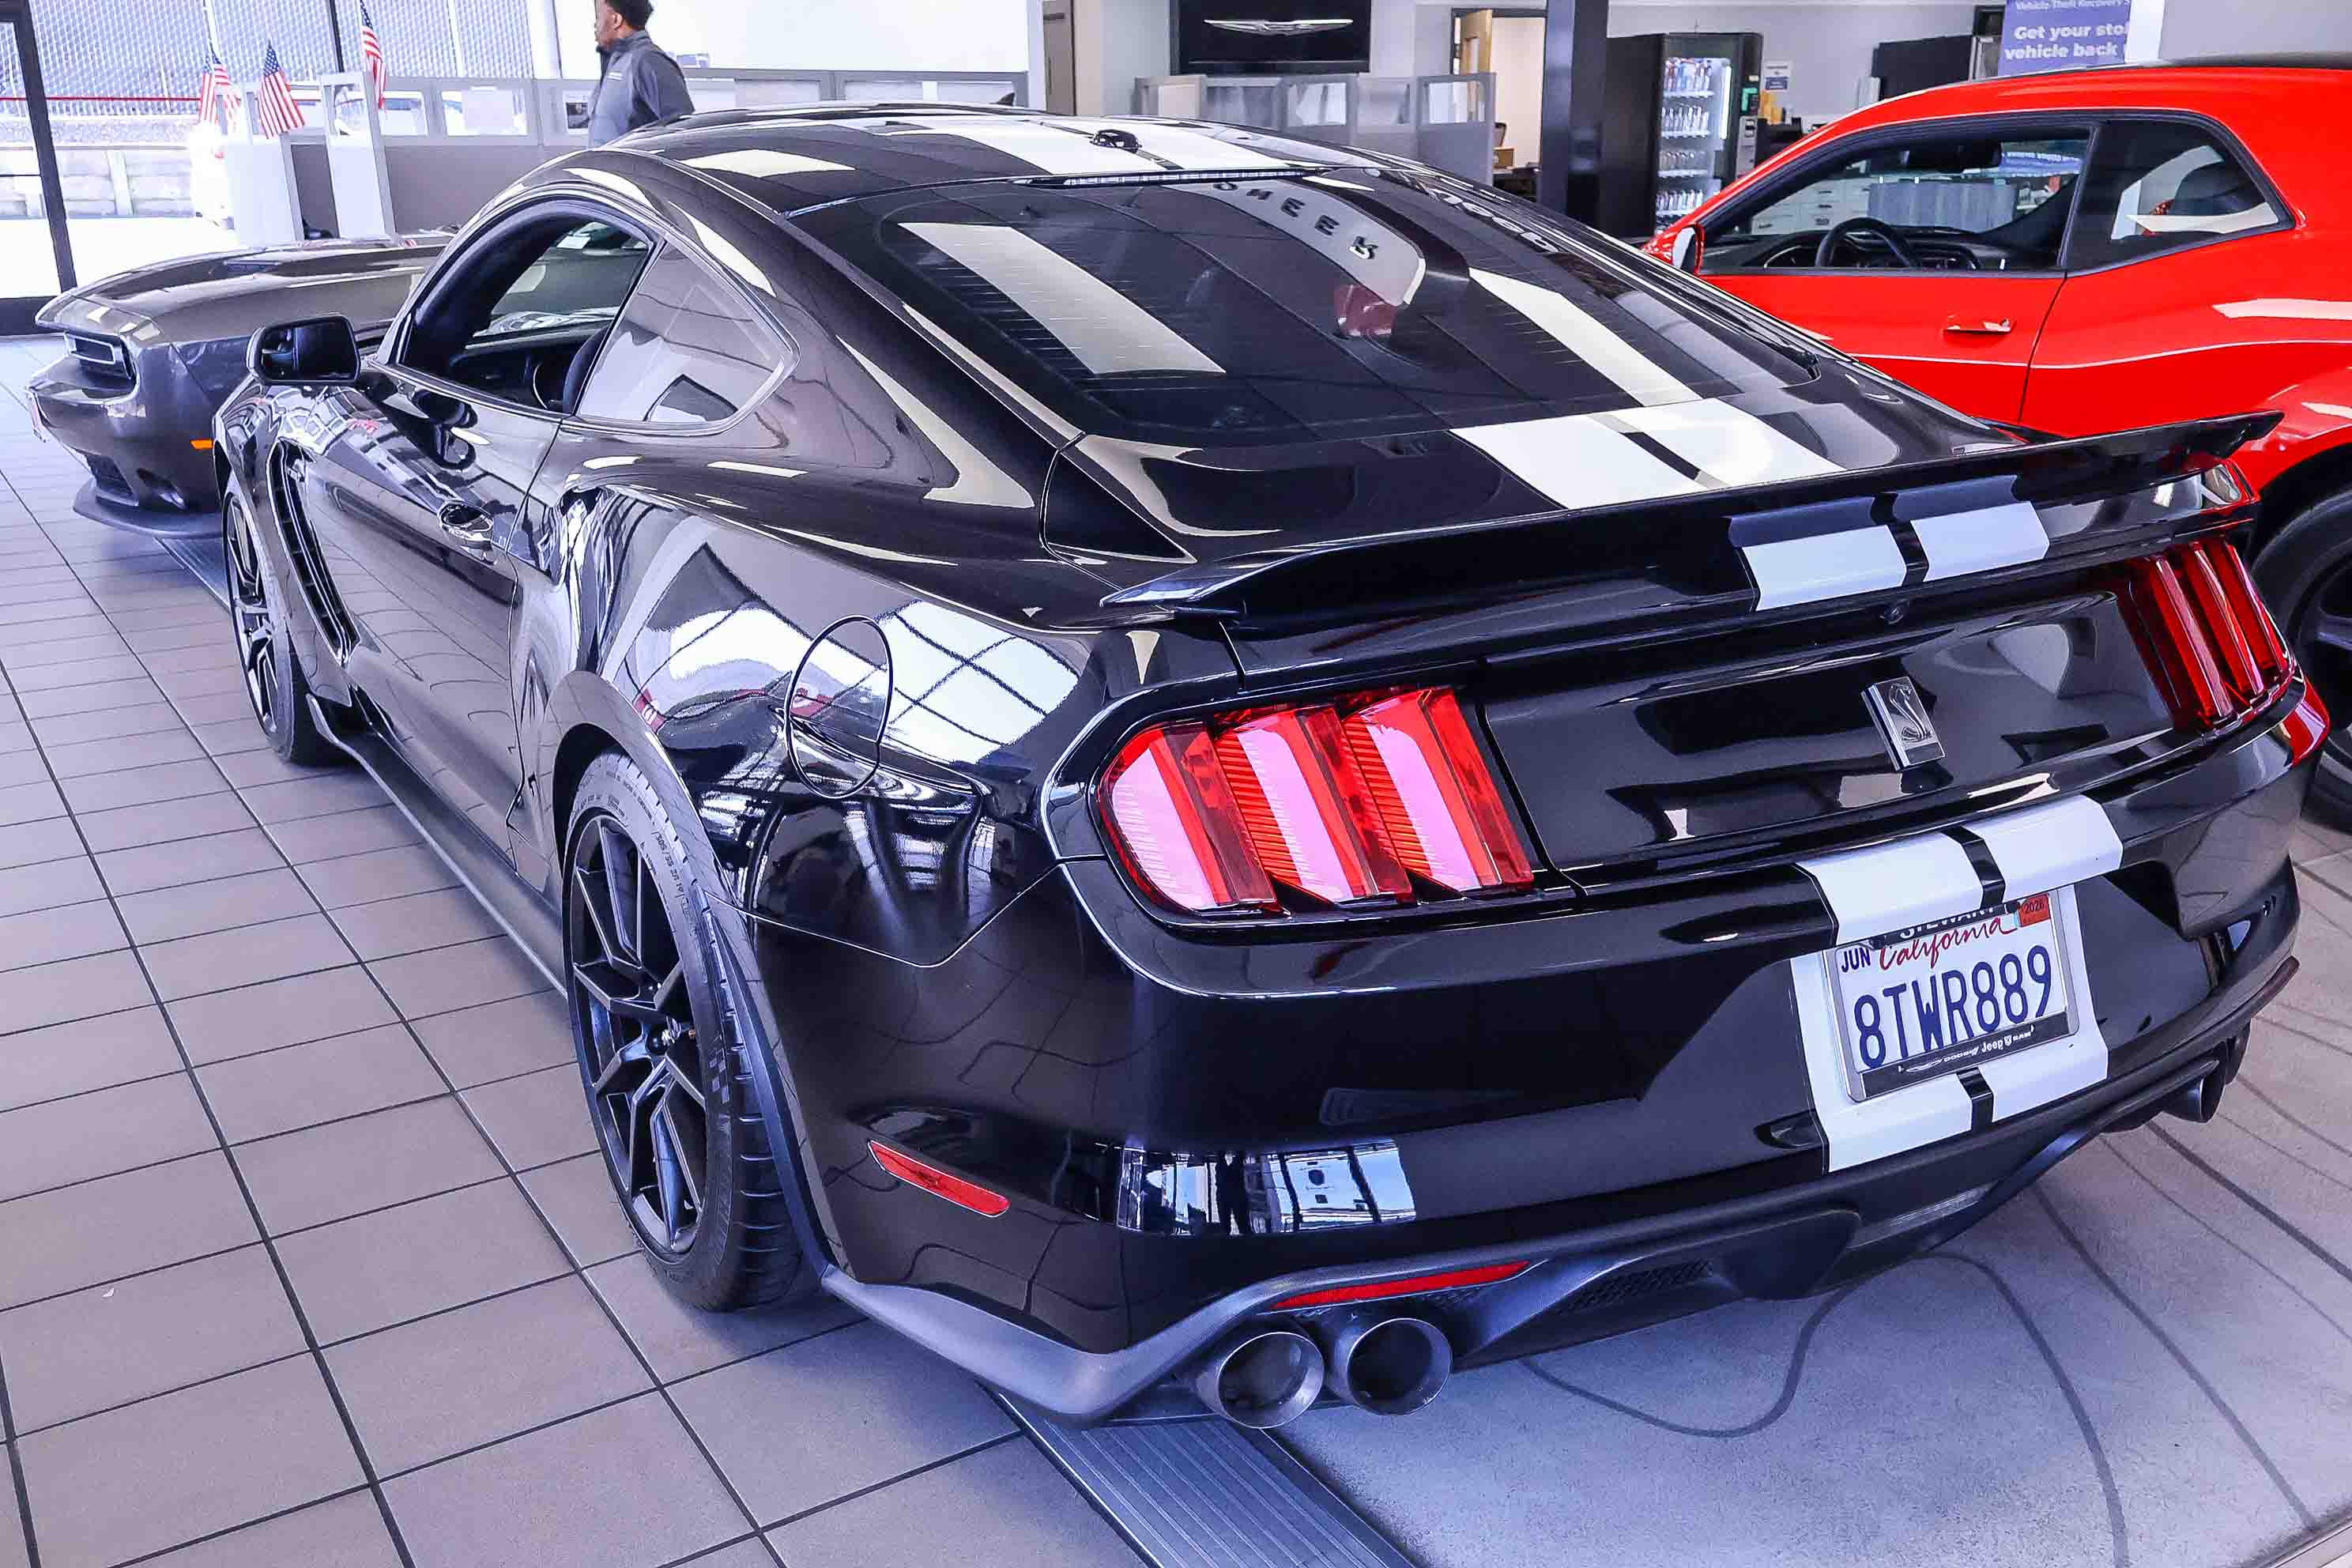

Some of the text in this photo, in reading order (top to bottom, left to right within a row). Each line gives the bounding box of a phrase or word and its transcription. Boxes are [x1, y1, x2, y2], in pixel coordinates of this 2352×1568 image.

[2014, 25, 2046, 40] Get
[2049, 24, 2092, 41] your
[2004, 43, 2118, 59] vehicle back
[1841, 948, 1871, 973] JUN
[1879, 914, 2018, 971] California
[1853, 944, 2052, 1069] 8TWR889
[1981, 1038, 2003, 1054] Jeep
